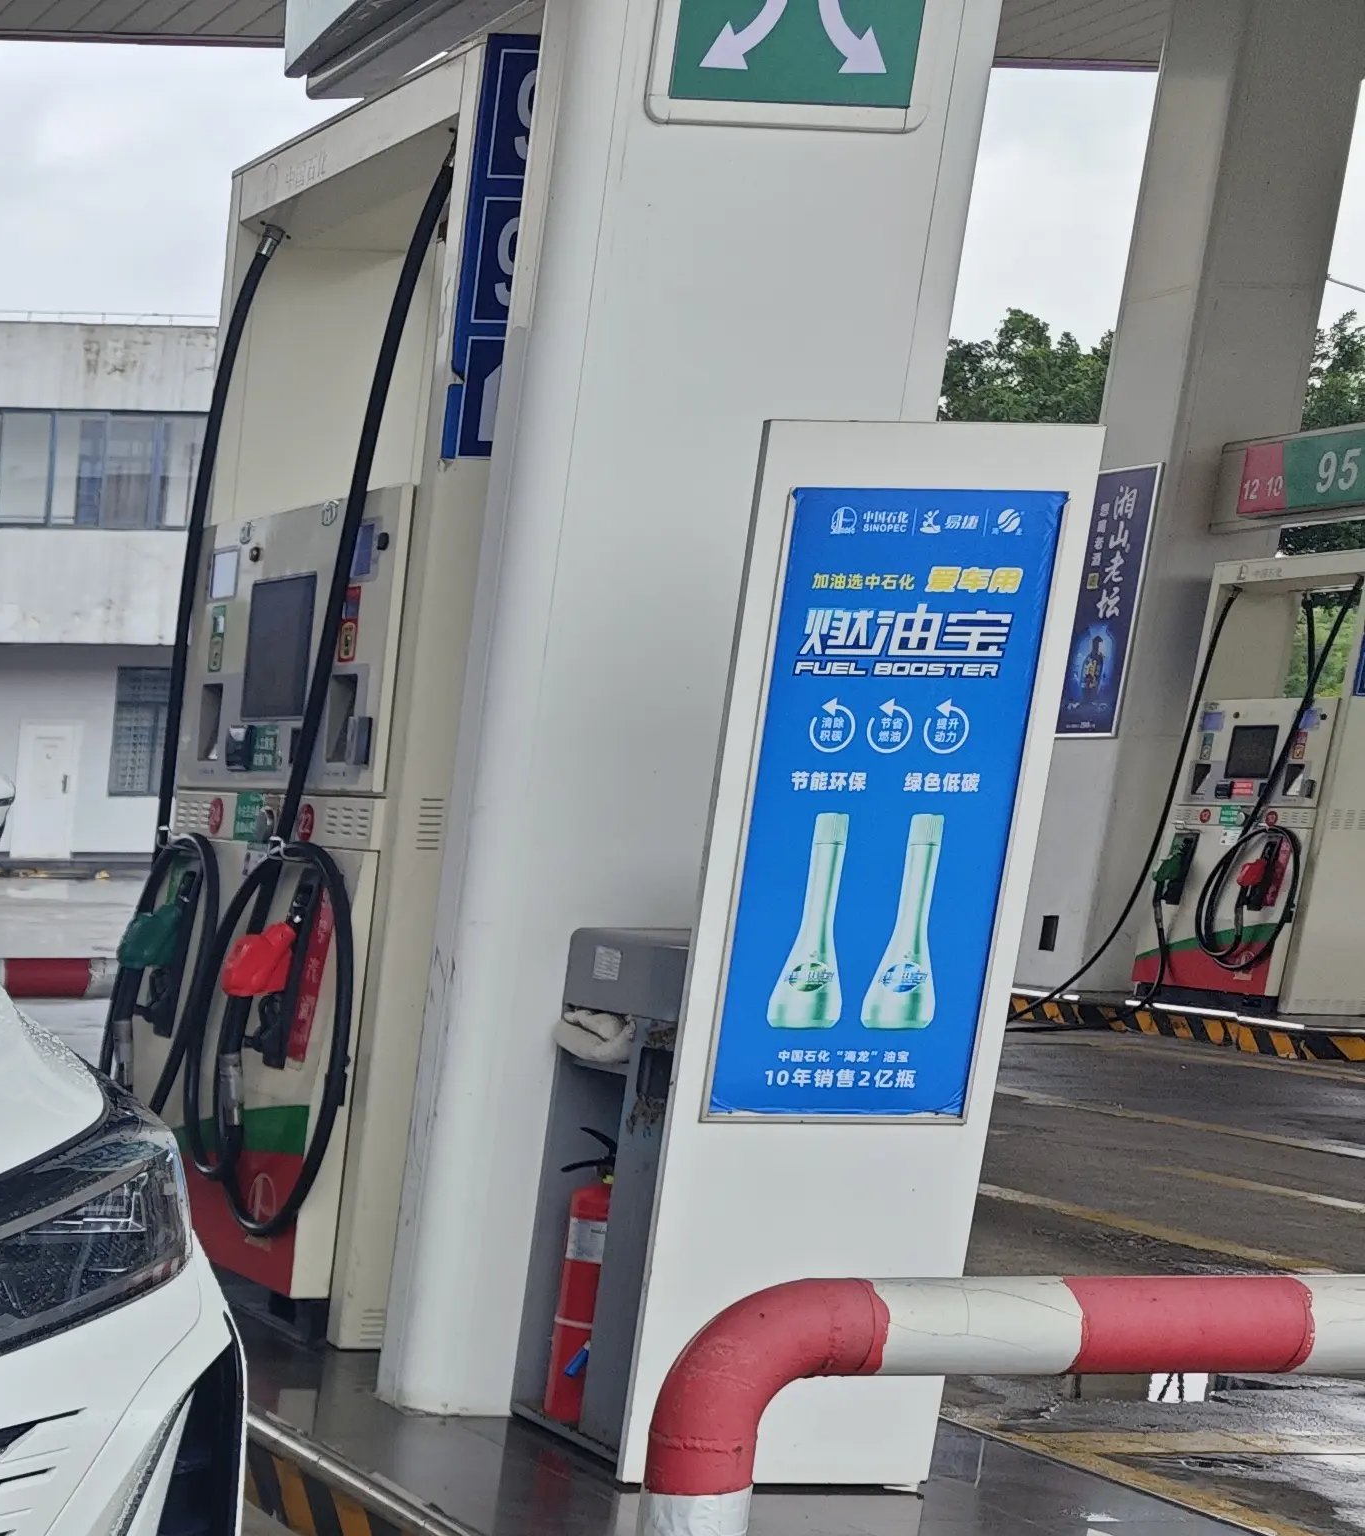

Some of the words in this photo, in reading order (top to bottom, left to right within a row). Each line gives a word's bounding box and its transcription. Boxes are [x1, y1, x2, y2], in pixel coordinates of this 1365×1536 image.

[1243, 479, 1260, 500] 12
[1267, 475, 1283, 497] 10
[1316, 448, 1362, 493] 95
[862, 510, 909, 524] 中国石化
[944, 514, 980, 530] 易捷
[862, 523, 908, 533] SINOPEC
[1096, 485, 1138, 619] 湘山老坛
[811, 573, 916, 590] 加油选中石化
[924, 566, 1024, 594] 爱车用
[800, 603, 1012, 657] 燃油宝
[794, 661, 867, 676] FUEL
[873, 662, 1000, 678] BOOSTER
[821, 716, 845, 729] 清除
[880, 717, 904, 730] 节省
[936, 717, 960, 731] 提升
[819, 730, 843, 743] 积碳
[877, 731, 902, 744] 燃油
[934, 731, 958, 744] 动力
[791, 770, 868, 792] 节能环保
[903, 772, 981, 793] 绿色低碳
[765, 1068, 917, 1089] 10年销售2亿瓶
